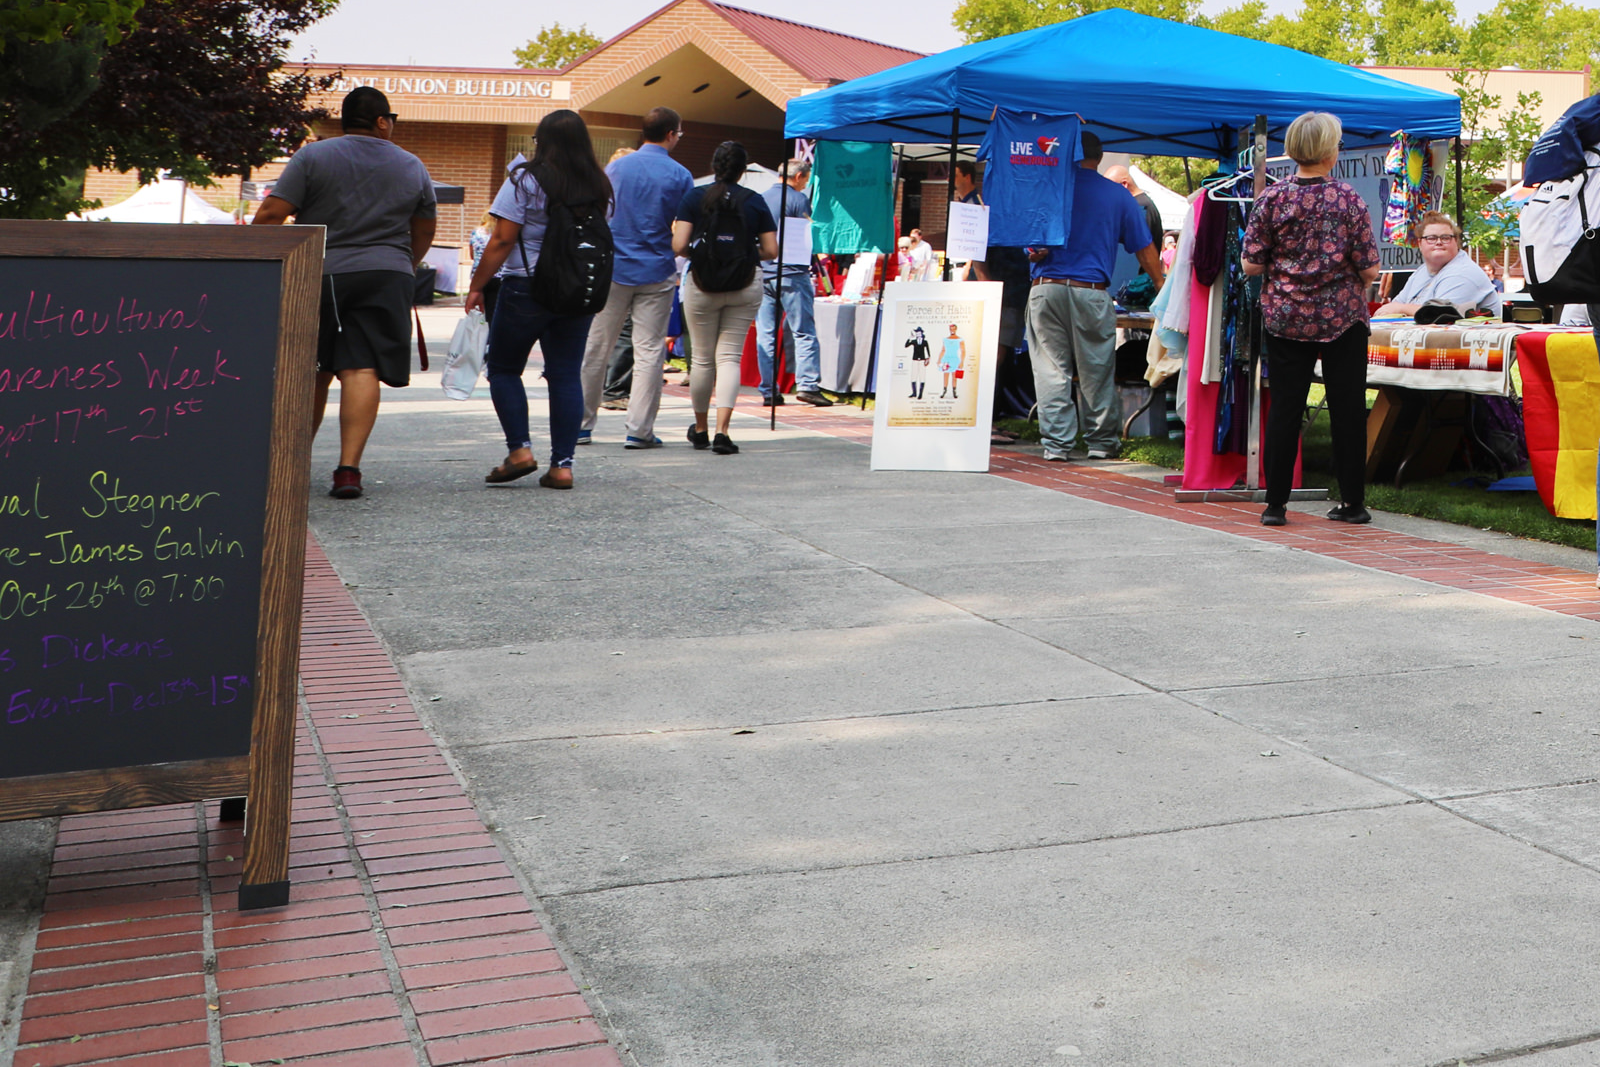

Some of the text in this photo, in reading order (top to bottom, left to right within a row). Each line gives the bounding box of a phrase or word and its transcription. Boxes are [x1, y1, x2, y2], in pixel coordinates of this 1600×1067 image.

[384, 77, 449, 95] UNION
[455, 80, 551, 98] BUILDING
[1010, 141, 1033, 155] LIVE
[0, 290, 212, 341] ulticultural
[0, 345, 241, 392] areness Week
[82, 470, 220, 528] Stegner
[153, 525, 244, 561] Galvin
[0, 580, 57, 620] Oct
[134, 579, 155, 607] @
[41, 633, 174, 669] Dickens
